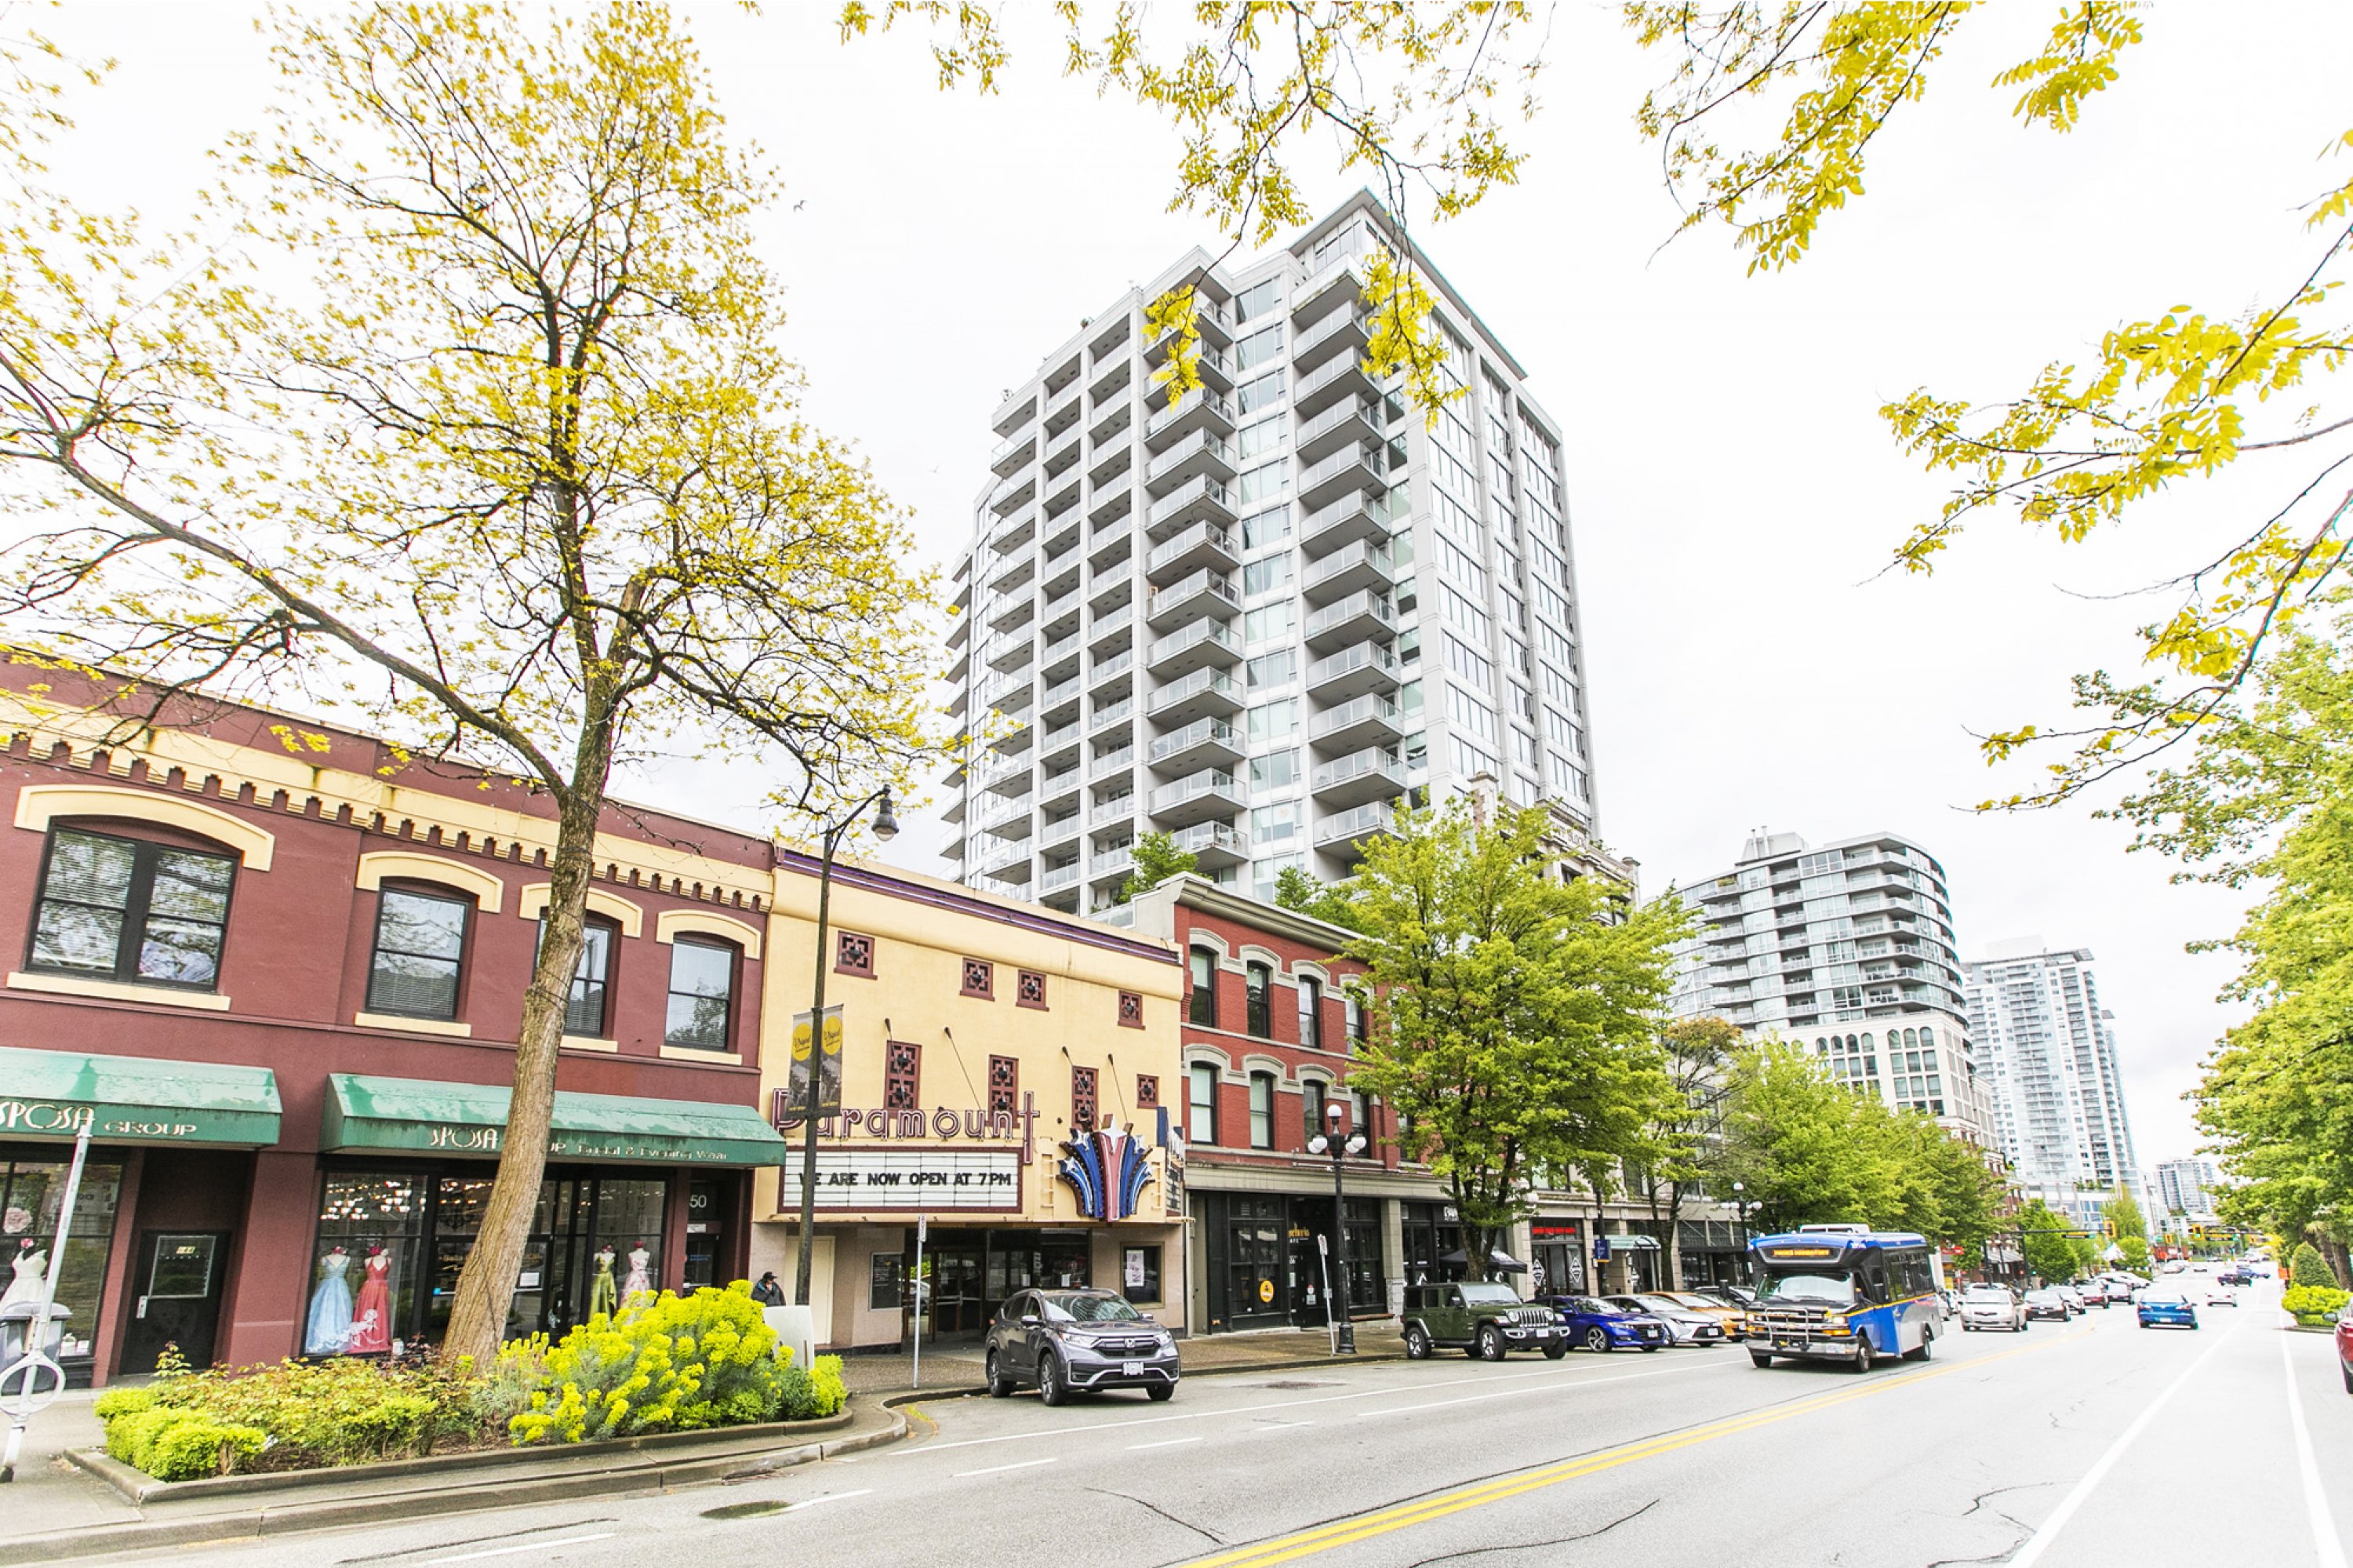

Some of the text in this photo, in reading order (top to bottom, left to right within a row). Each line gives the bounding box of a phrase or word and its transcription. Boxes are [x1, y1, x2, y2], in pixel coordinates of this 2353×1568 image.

[0, 1101, 198, 1136] SPOSA GROUP
[430, 1126, 498, 1149] SPOSA
[626, 1146, 635, 1155] &
[696, 1151, 727, 1160] Wear
[828, 1173, 859, 1185] ARE
[867, 1173, 900, 1185] NOW
[909, 1173, 947, 1185] OPEN
[953, 1173, 972, 1185] AT
